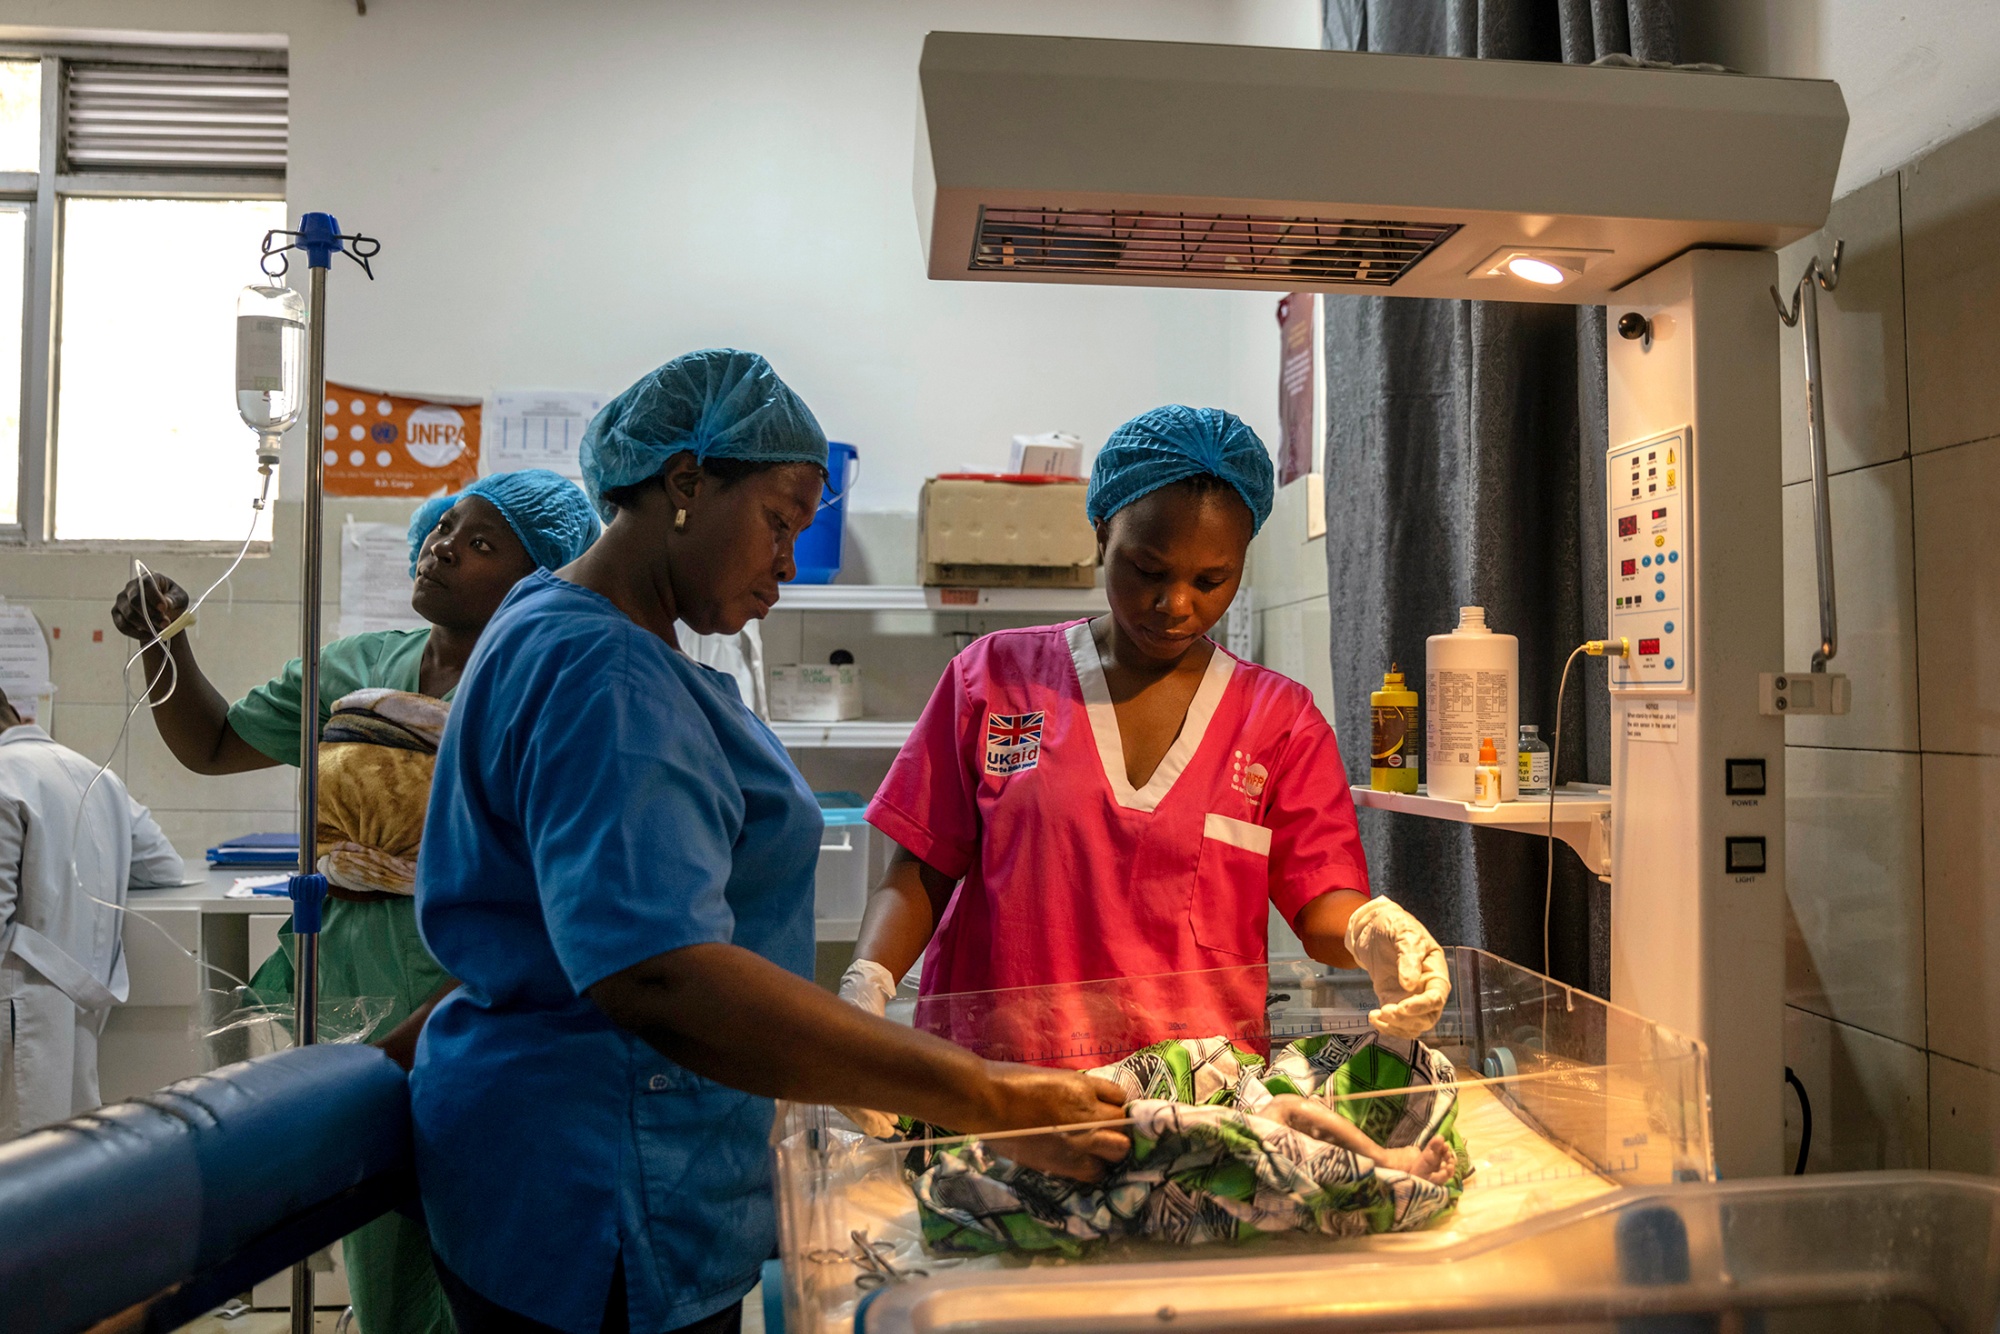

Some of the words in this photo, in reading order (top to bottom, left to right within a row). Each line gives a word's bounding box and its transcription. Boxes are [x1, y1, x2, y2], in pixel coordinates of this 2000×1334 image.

[391, 479, 414, 490] Congo
[987, 745, 1038, 765] UKaid
[987, 764, 998, 772] from
[1007, 764, 1021, 772] British
[1021, 761, 1037, 769] people
[1071, 1031, 1090, 1040] 40cm
